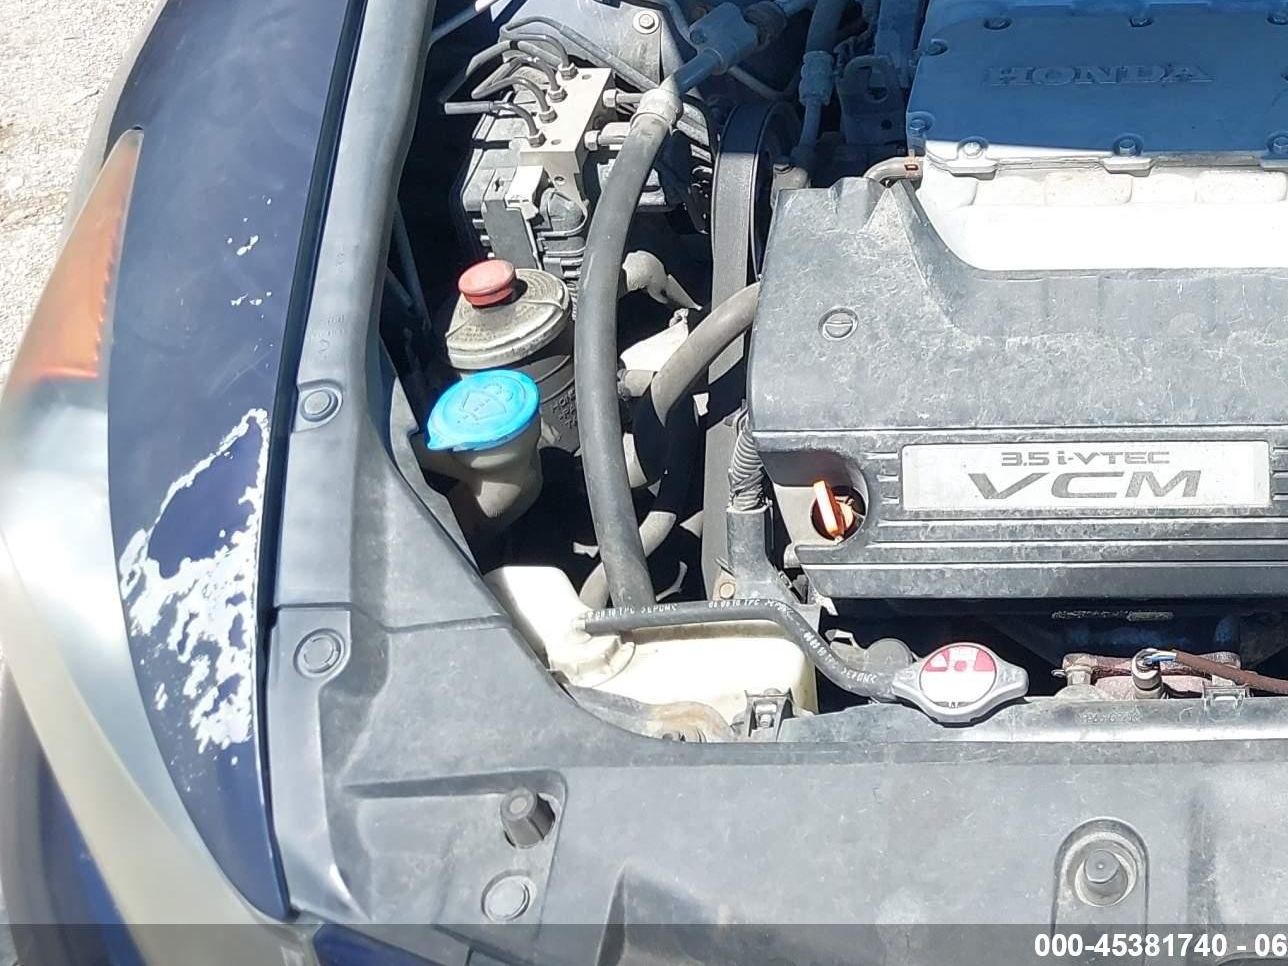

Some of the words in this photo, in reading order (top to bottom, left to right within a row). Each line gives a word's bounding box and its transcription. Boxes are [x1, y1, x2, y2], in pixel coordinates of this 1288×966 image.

[982, 63, 1215, 86] HONDA
[1001, 451, 1050, 467] 3.5
[1057, 450, 1171, 466] i-VTEC
[967, 469, 1202, 500] VCM
